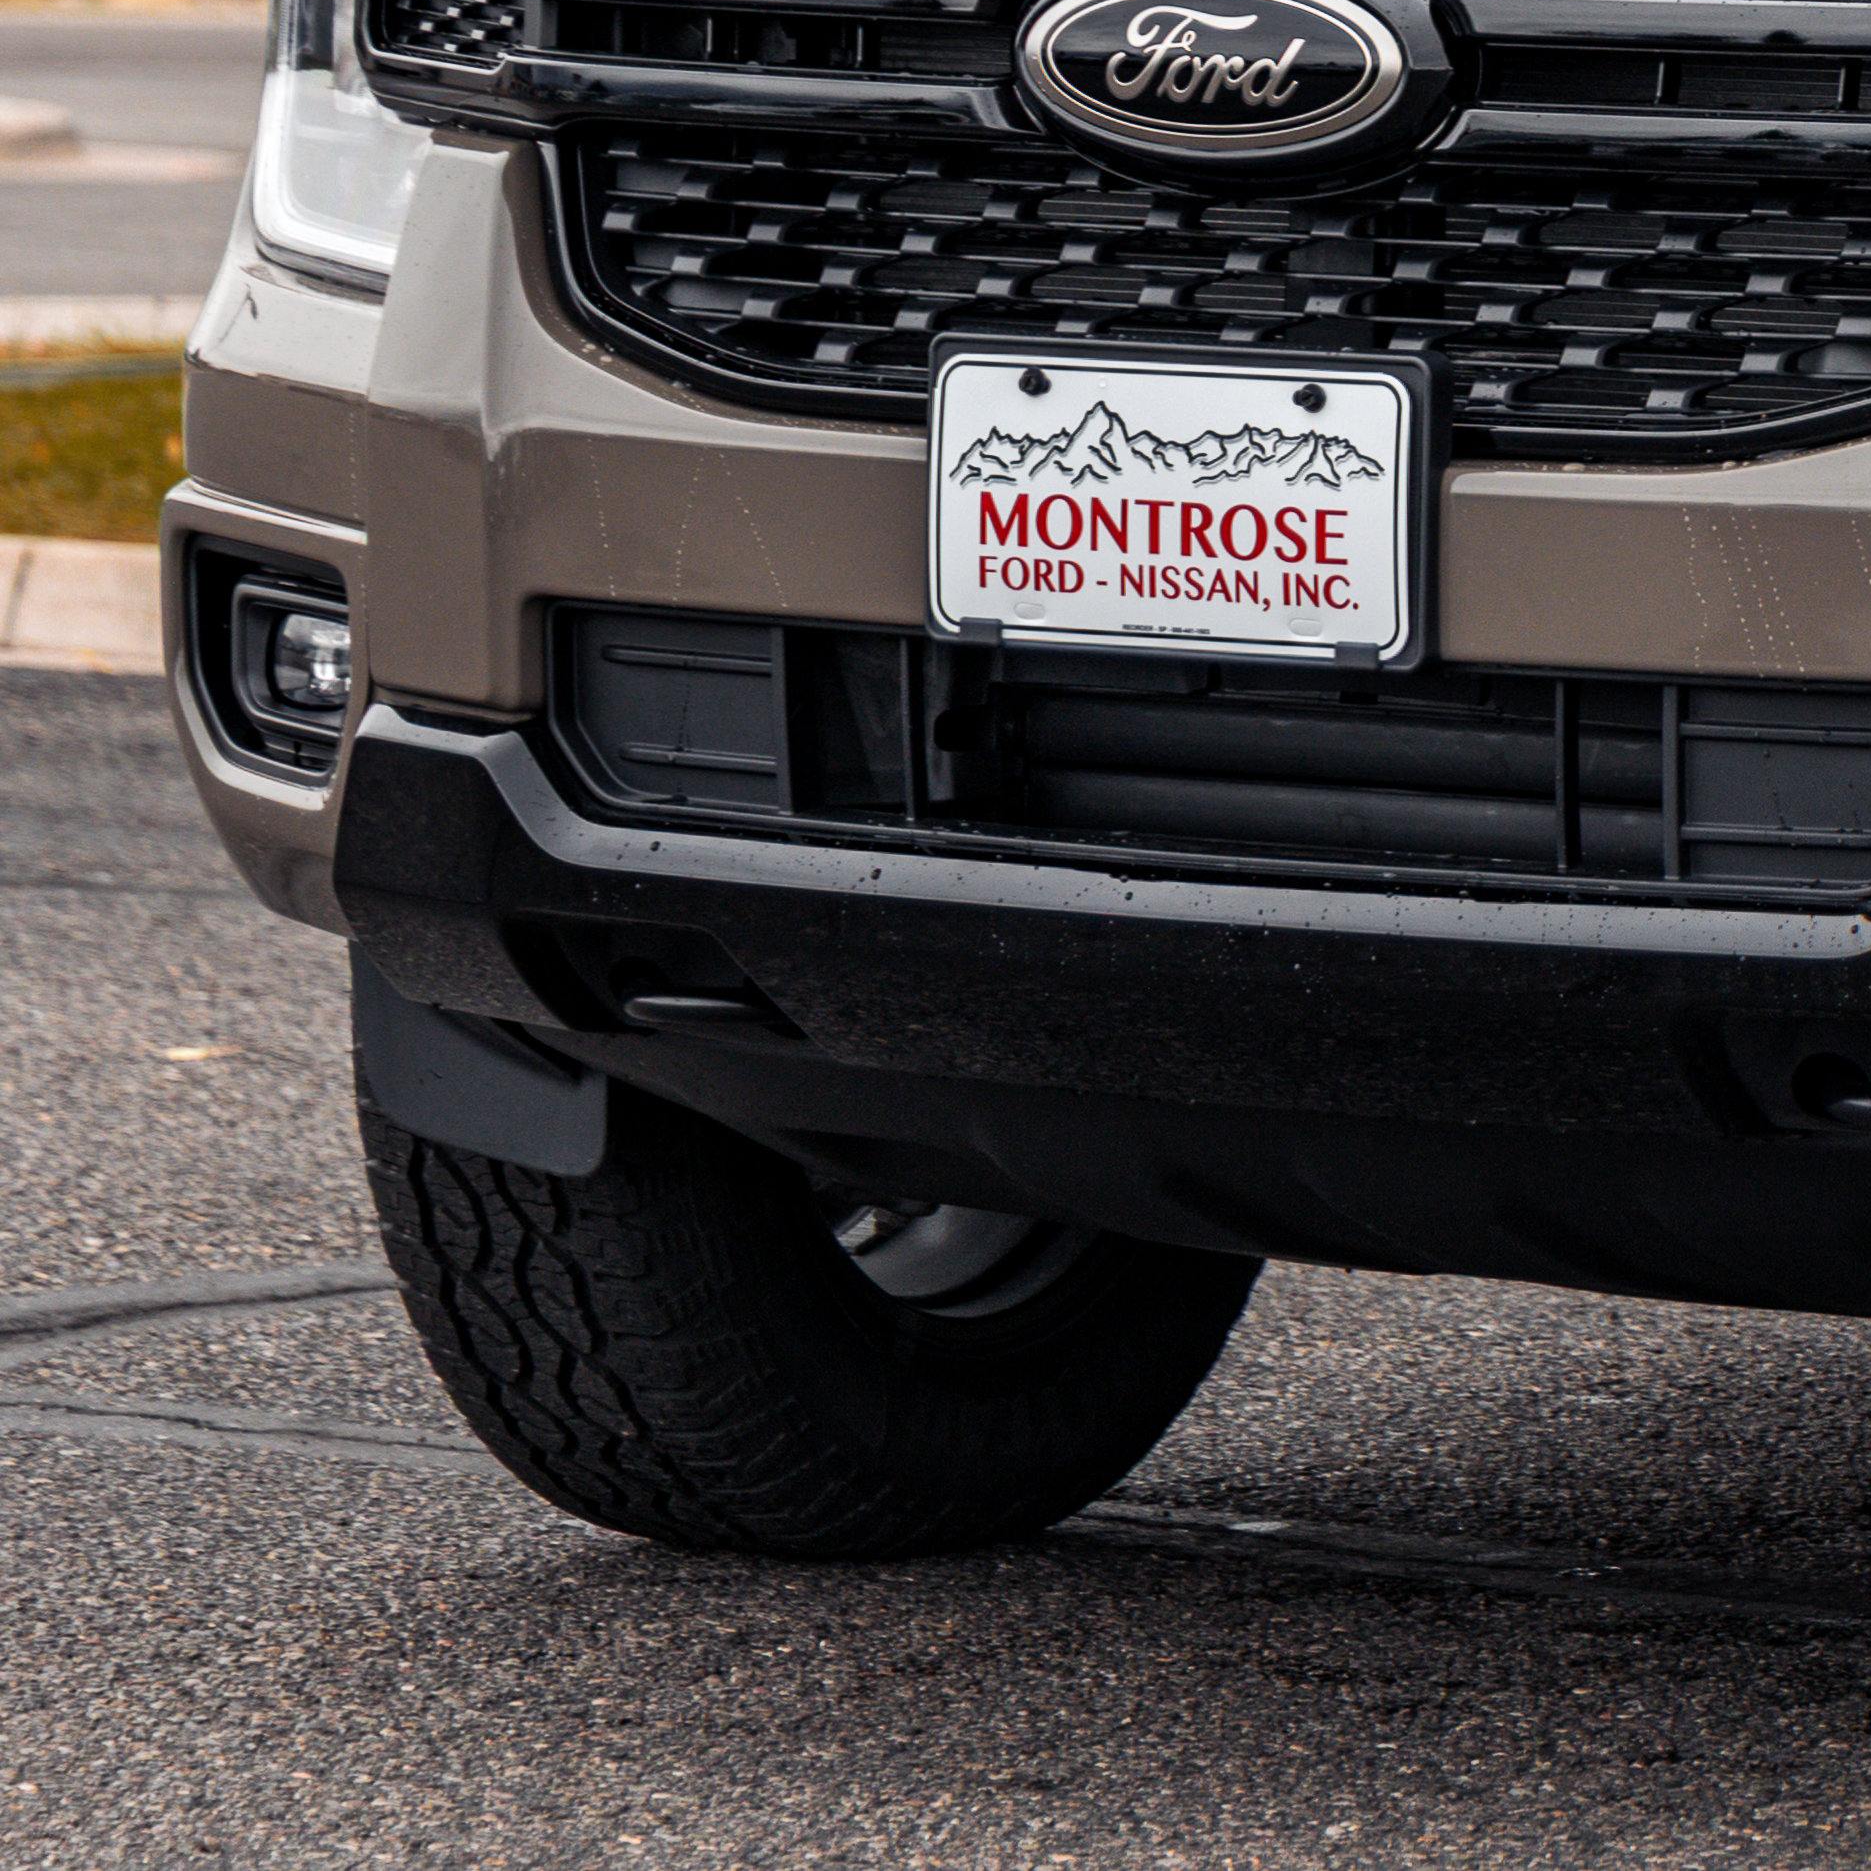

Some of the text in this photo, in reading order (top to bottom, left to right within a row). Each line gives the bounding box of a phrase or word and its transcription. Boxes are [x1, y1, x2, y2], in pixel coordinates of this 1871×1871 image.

[1106, 5, 1306, 107] Ford
[978, 491, 1349, 566] MONTROSE
[977, 555, 1085, 594] FORD
[1119, 563, 1271, 612] NISSAN,
[1282, 572, 1360, 611] INC.
